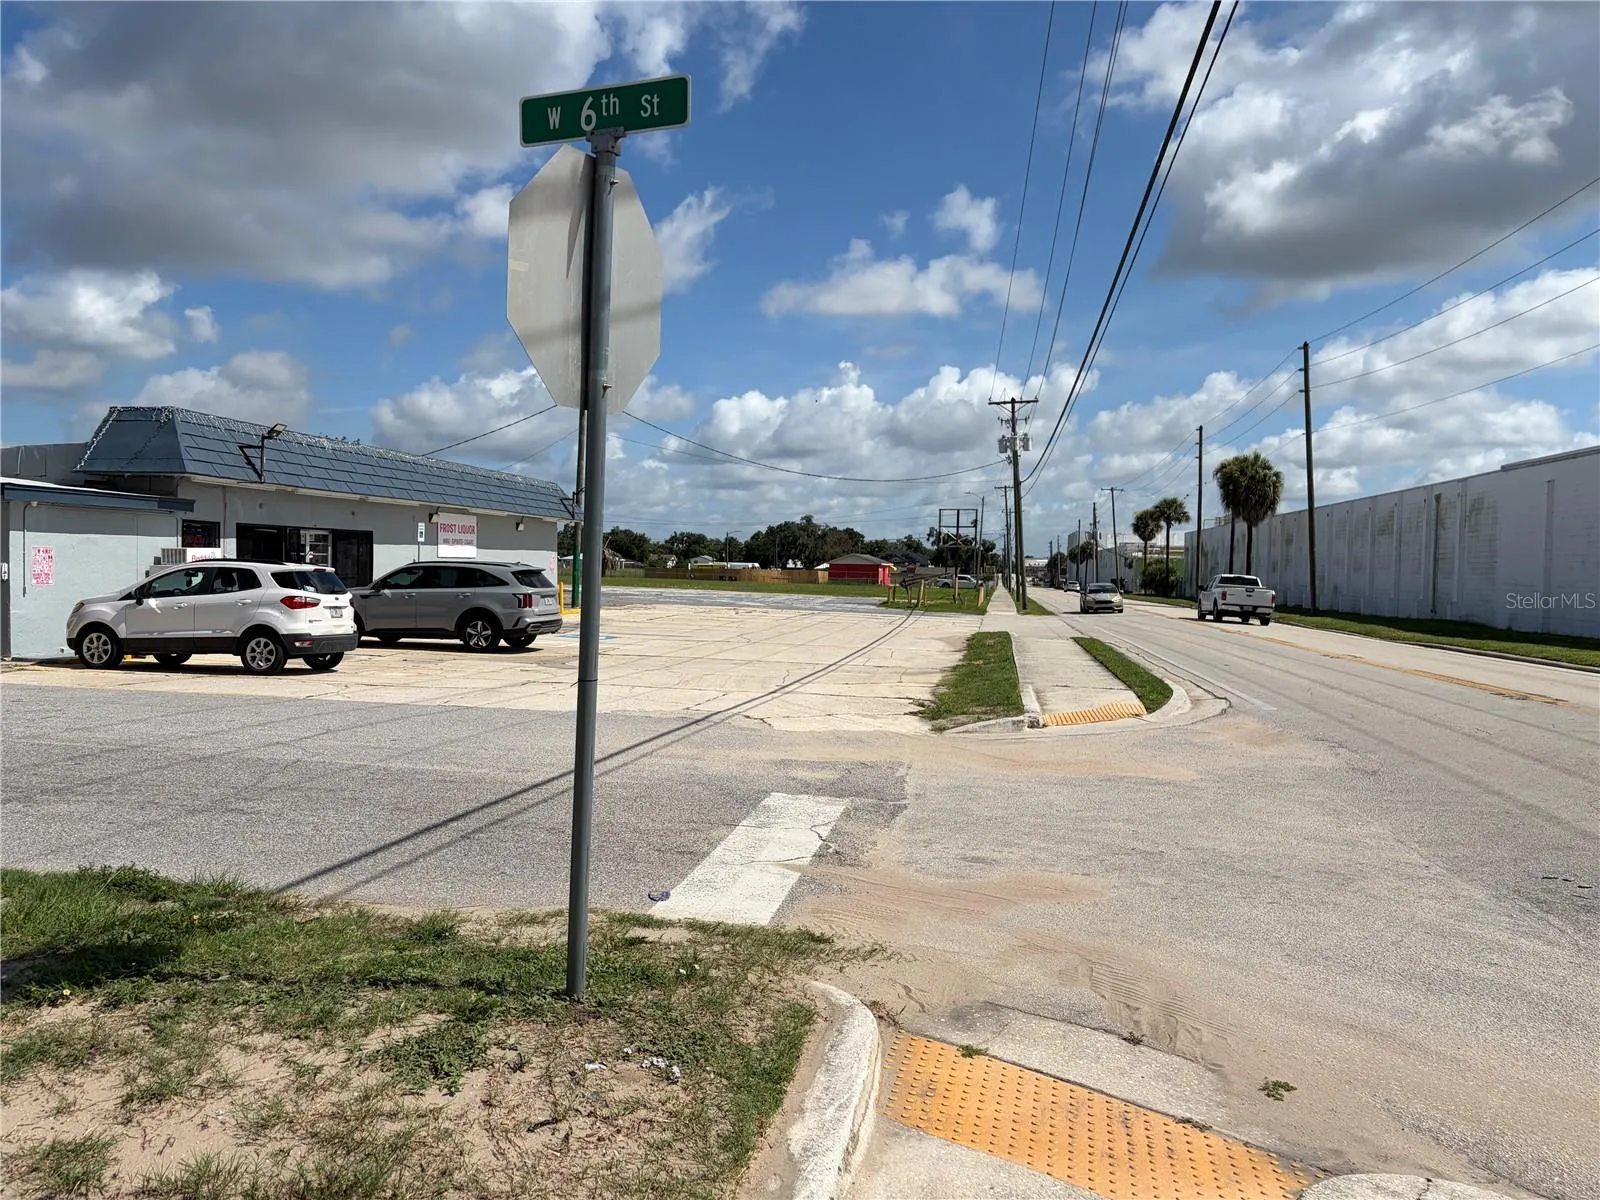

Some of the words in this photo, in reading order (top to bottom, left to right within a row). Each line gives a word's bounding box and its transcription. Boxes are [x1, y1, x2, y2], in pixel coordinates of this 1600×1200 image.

[547, 106, 561, 130] W
[580, 93, 620, 131] 6th
[640, 94, 660, 118] St
[440, 522, 456, 533] FROST
[458, 524, 475, 535] LIQUOR
